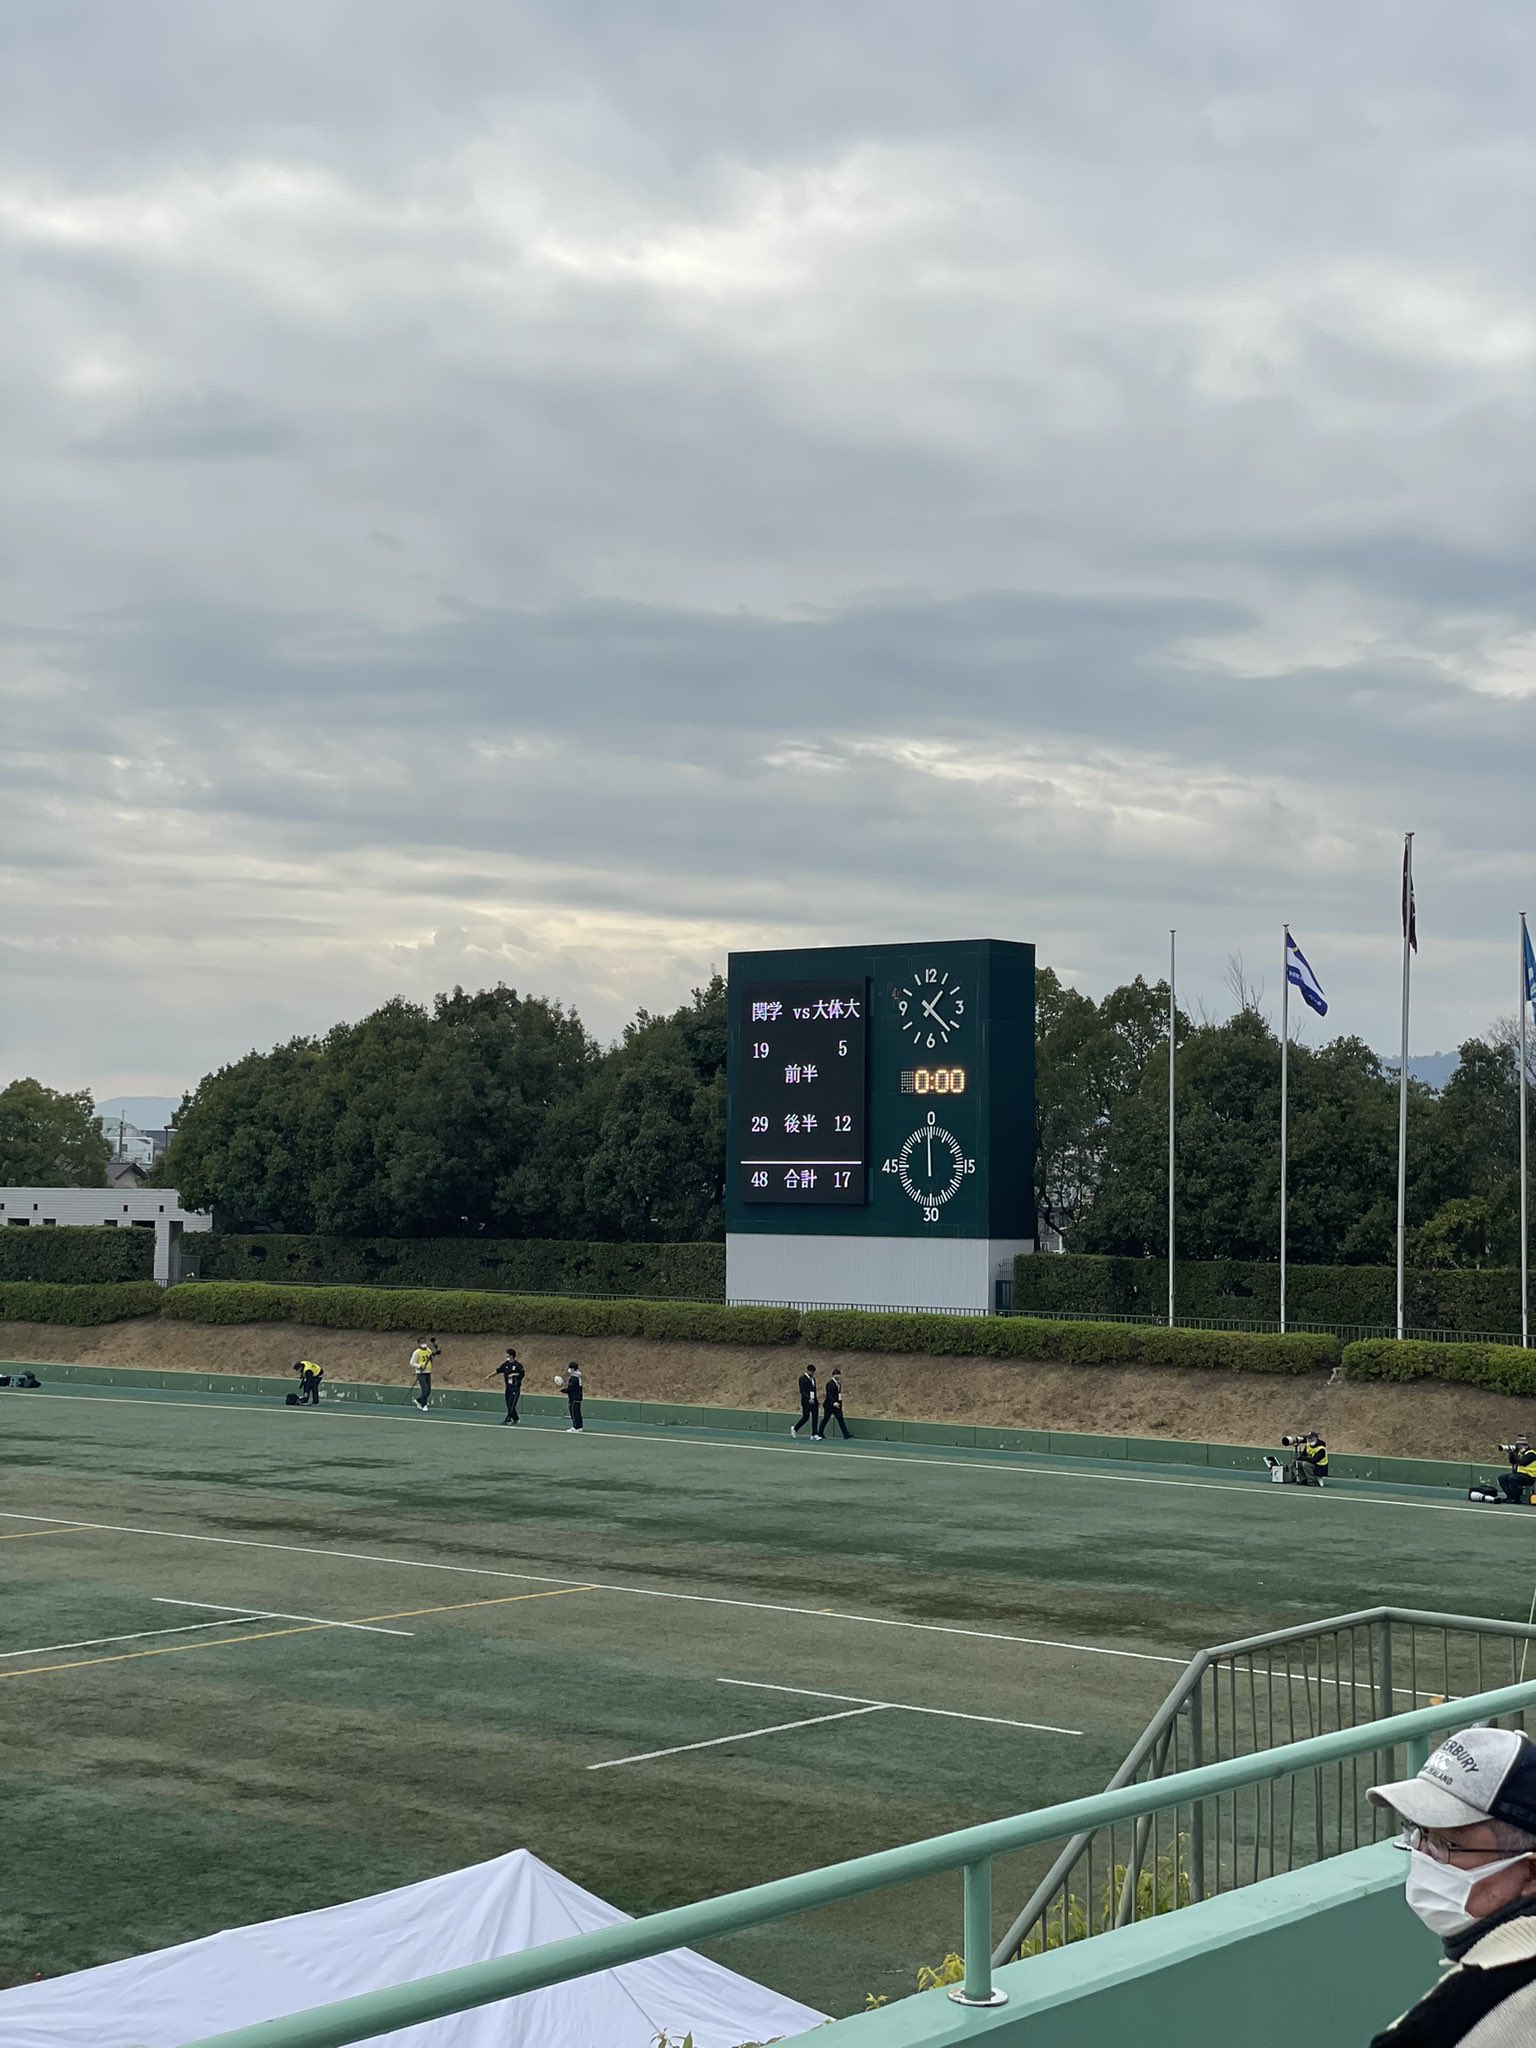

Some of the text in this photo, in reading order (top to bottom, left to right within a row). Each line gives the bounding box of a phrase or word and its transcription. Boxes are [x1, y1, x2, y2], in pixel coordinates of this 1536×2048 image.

[925, 968, 938, 984] 12
[752, 1001, 784, 1022] 関学
[898, 1000, 908, 1017] 9
[955, 999, 965, 1015] 3
[752, 1039, 848, 1059] 19 5
[926, 1032, 936, 1049] 6
[784, 1063, 819, 1084] 前半
[914, 1068, 966, 1094] 0:00
[751, 1113, 852, 1134] 29 後半 12
[926, 1110, 936, 1126] 0
[881, 1158, 899, 1174] 45
[964, 1158, 976, 1174] 15
[750, 1168, 852, 1189] 48 合計 17
[923, 1207, 940, 1222] 30
